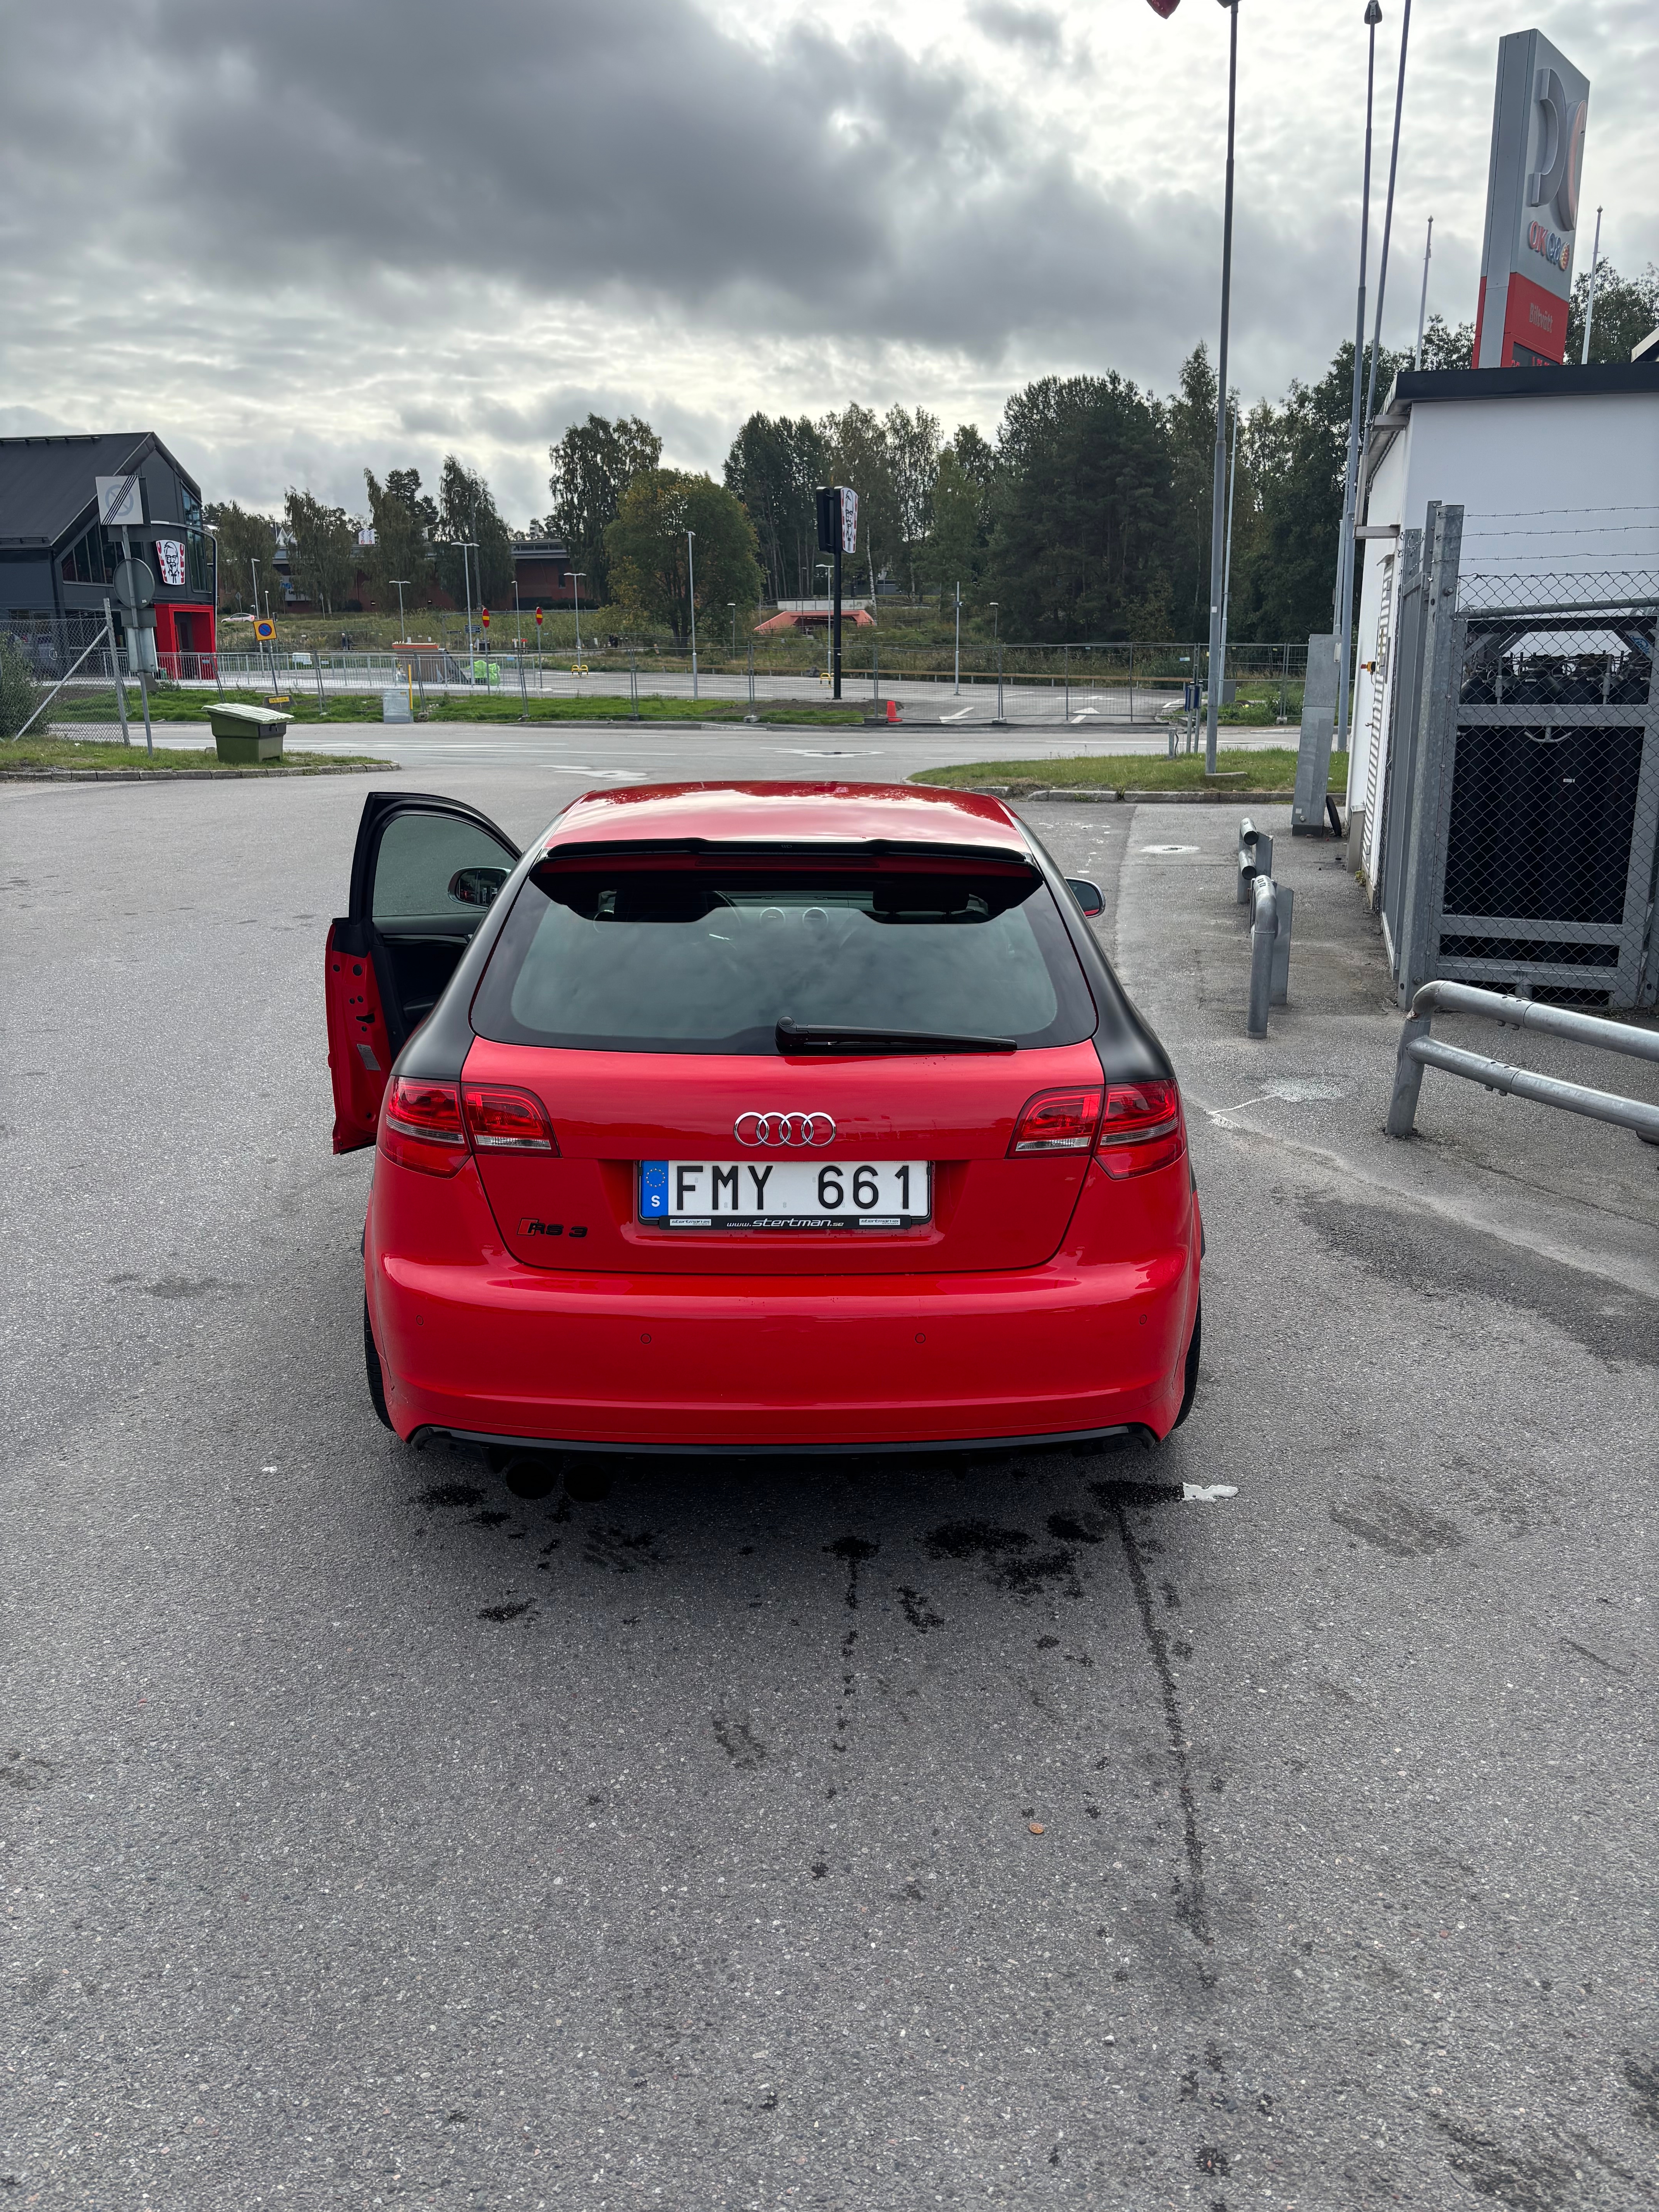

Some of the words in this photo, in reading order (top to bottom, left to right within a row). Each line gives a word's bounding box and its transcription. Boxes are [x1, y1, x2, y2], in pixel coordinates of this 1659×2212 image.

[157, 541, 168, 582] KFC
[677, 1166, 773, 1210] FMY
[818, 1166, 909, 1209] 661
[651, 1195, 660, 1207] S
[727, 1218, 844, 1226] www.stertman.se
[527, 1223, 564, 1235] RS
[568, 1226, 588, 1238] 3
